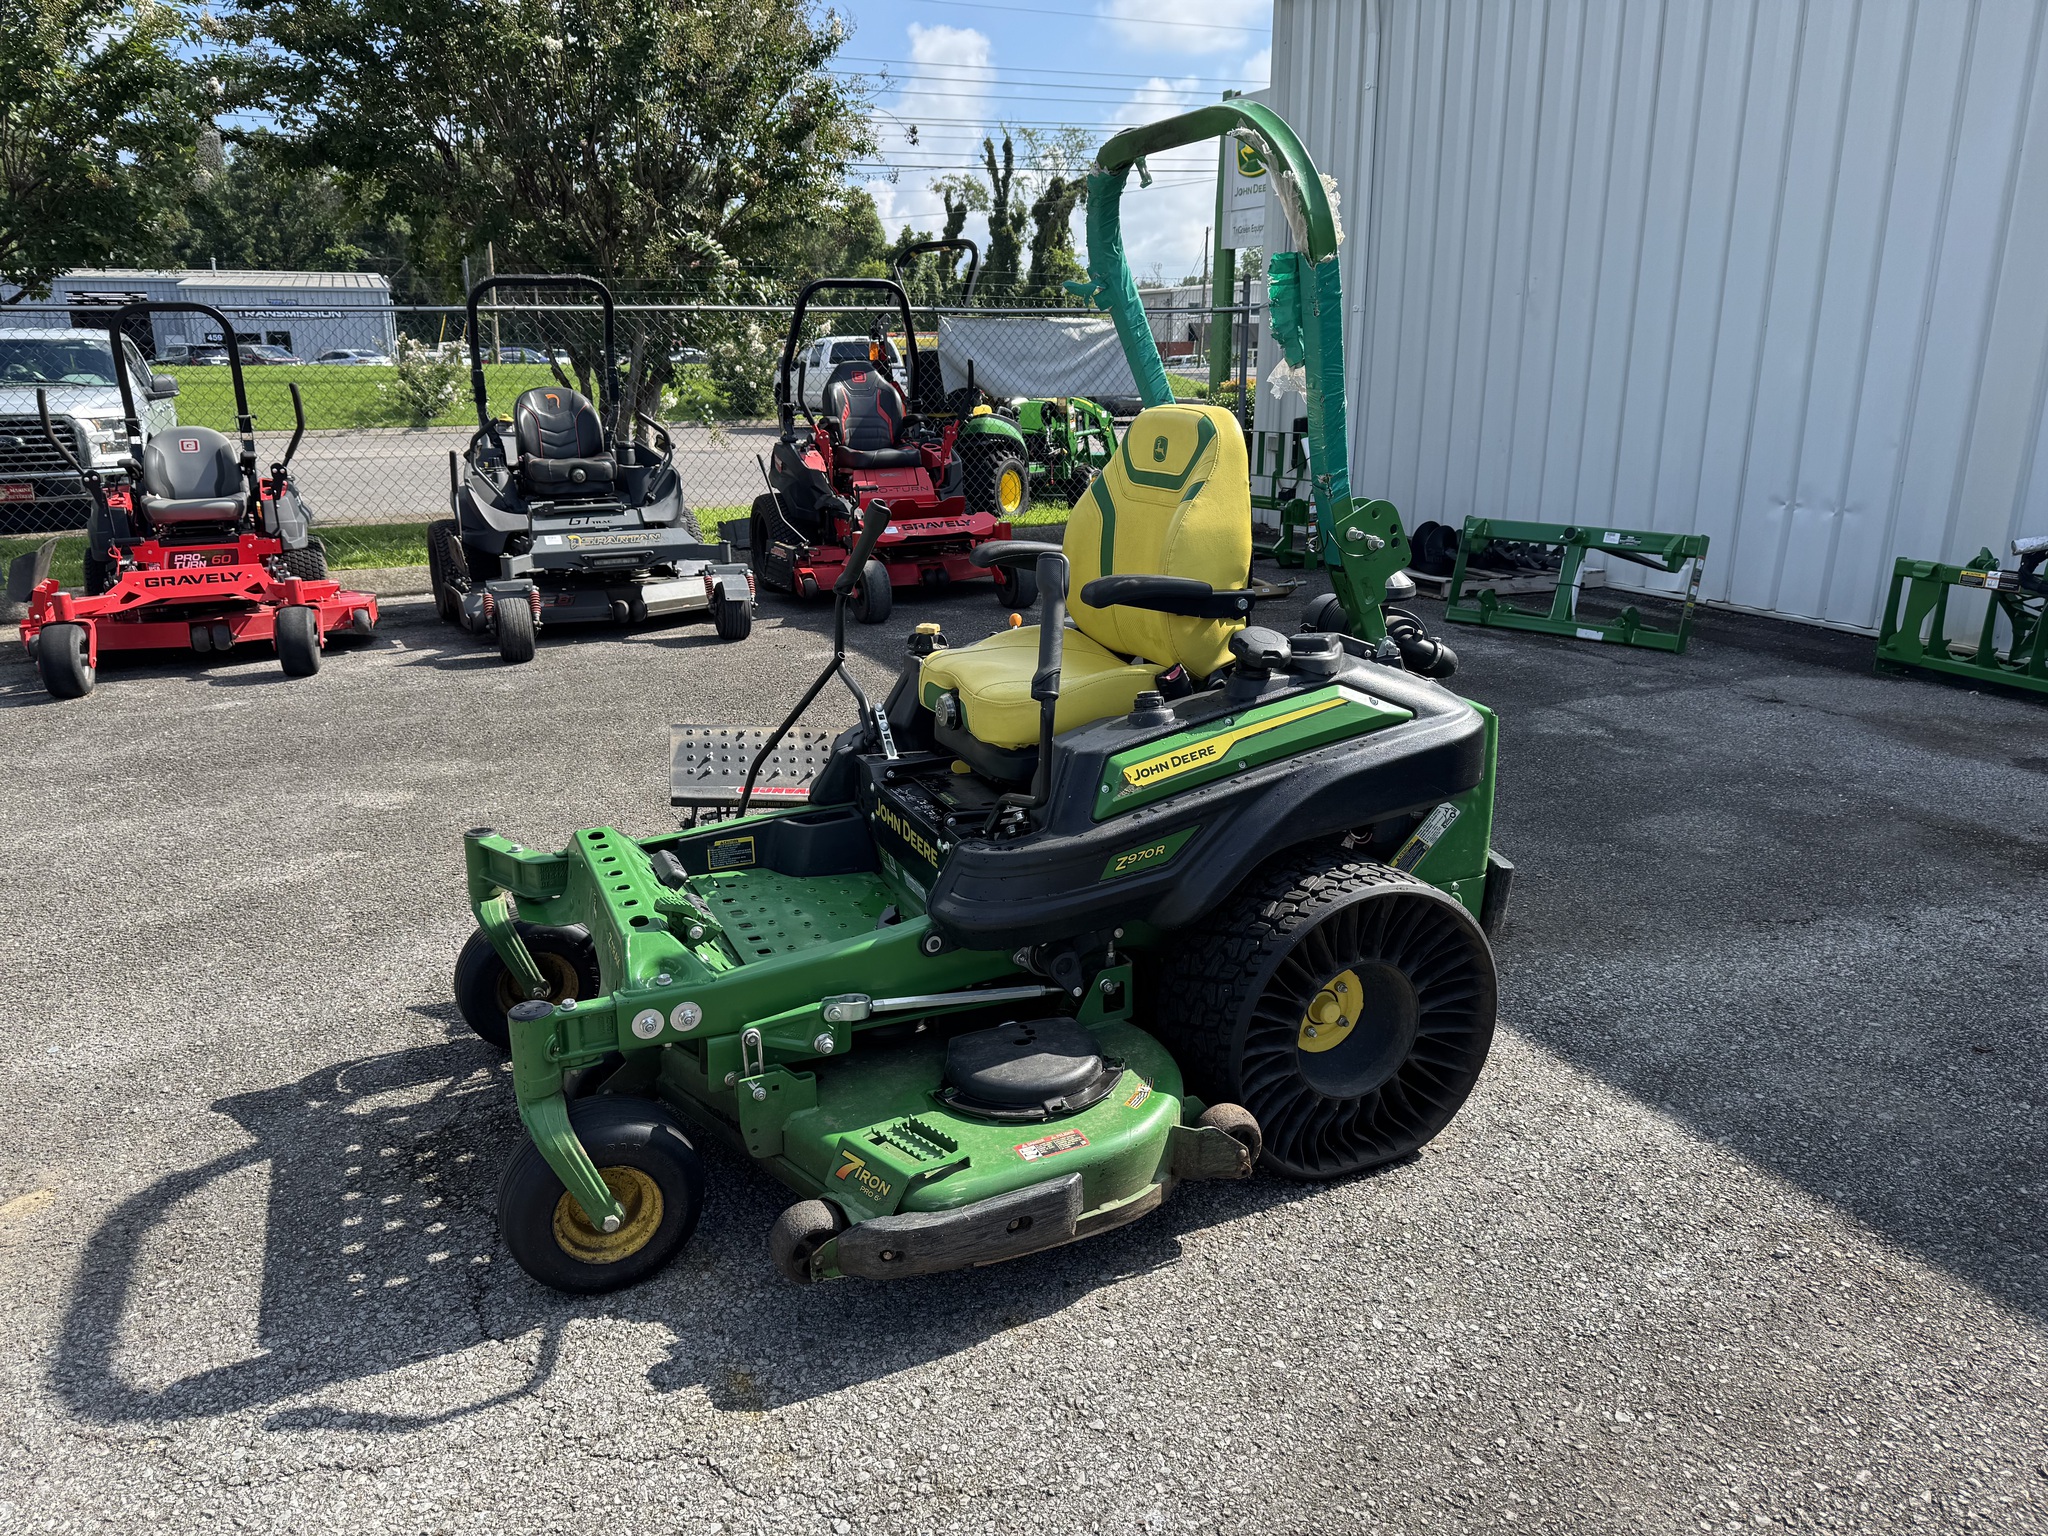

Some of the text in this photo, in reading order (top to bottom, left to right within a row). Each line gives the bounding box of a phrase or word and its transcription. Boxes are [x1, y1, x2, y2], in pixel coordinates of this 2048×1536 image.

[1234, 186, 1252, 197] JOHN
[901, 520, 971, 531] GRAVELY
[581, 533, 661, 546] SPARTAN
[174, 554, 206, 562] PRO-
[211, 555, 232, 564] 60
[174, 561, 207, 569] TURN
[144, 571, 243, 588] GRAVELY
[1133, 745, 1217, 782] JOHN DEERE
[875, 797, 901, 835] JOHN
[902, 819, 939, 869] DEERE
[1114, 845, 1165, 871] Z970R
[860, 1186, 874, 1198] PRO
